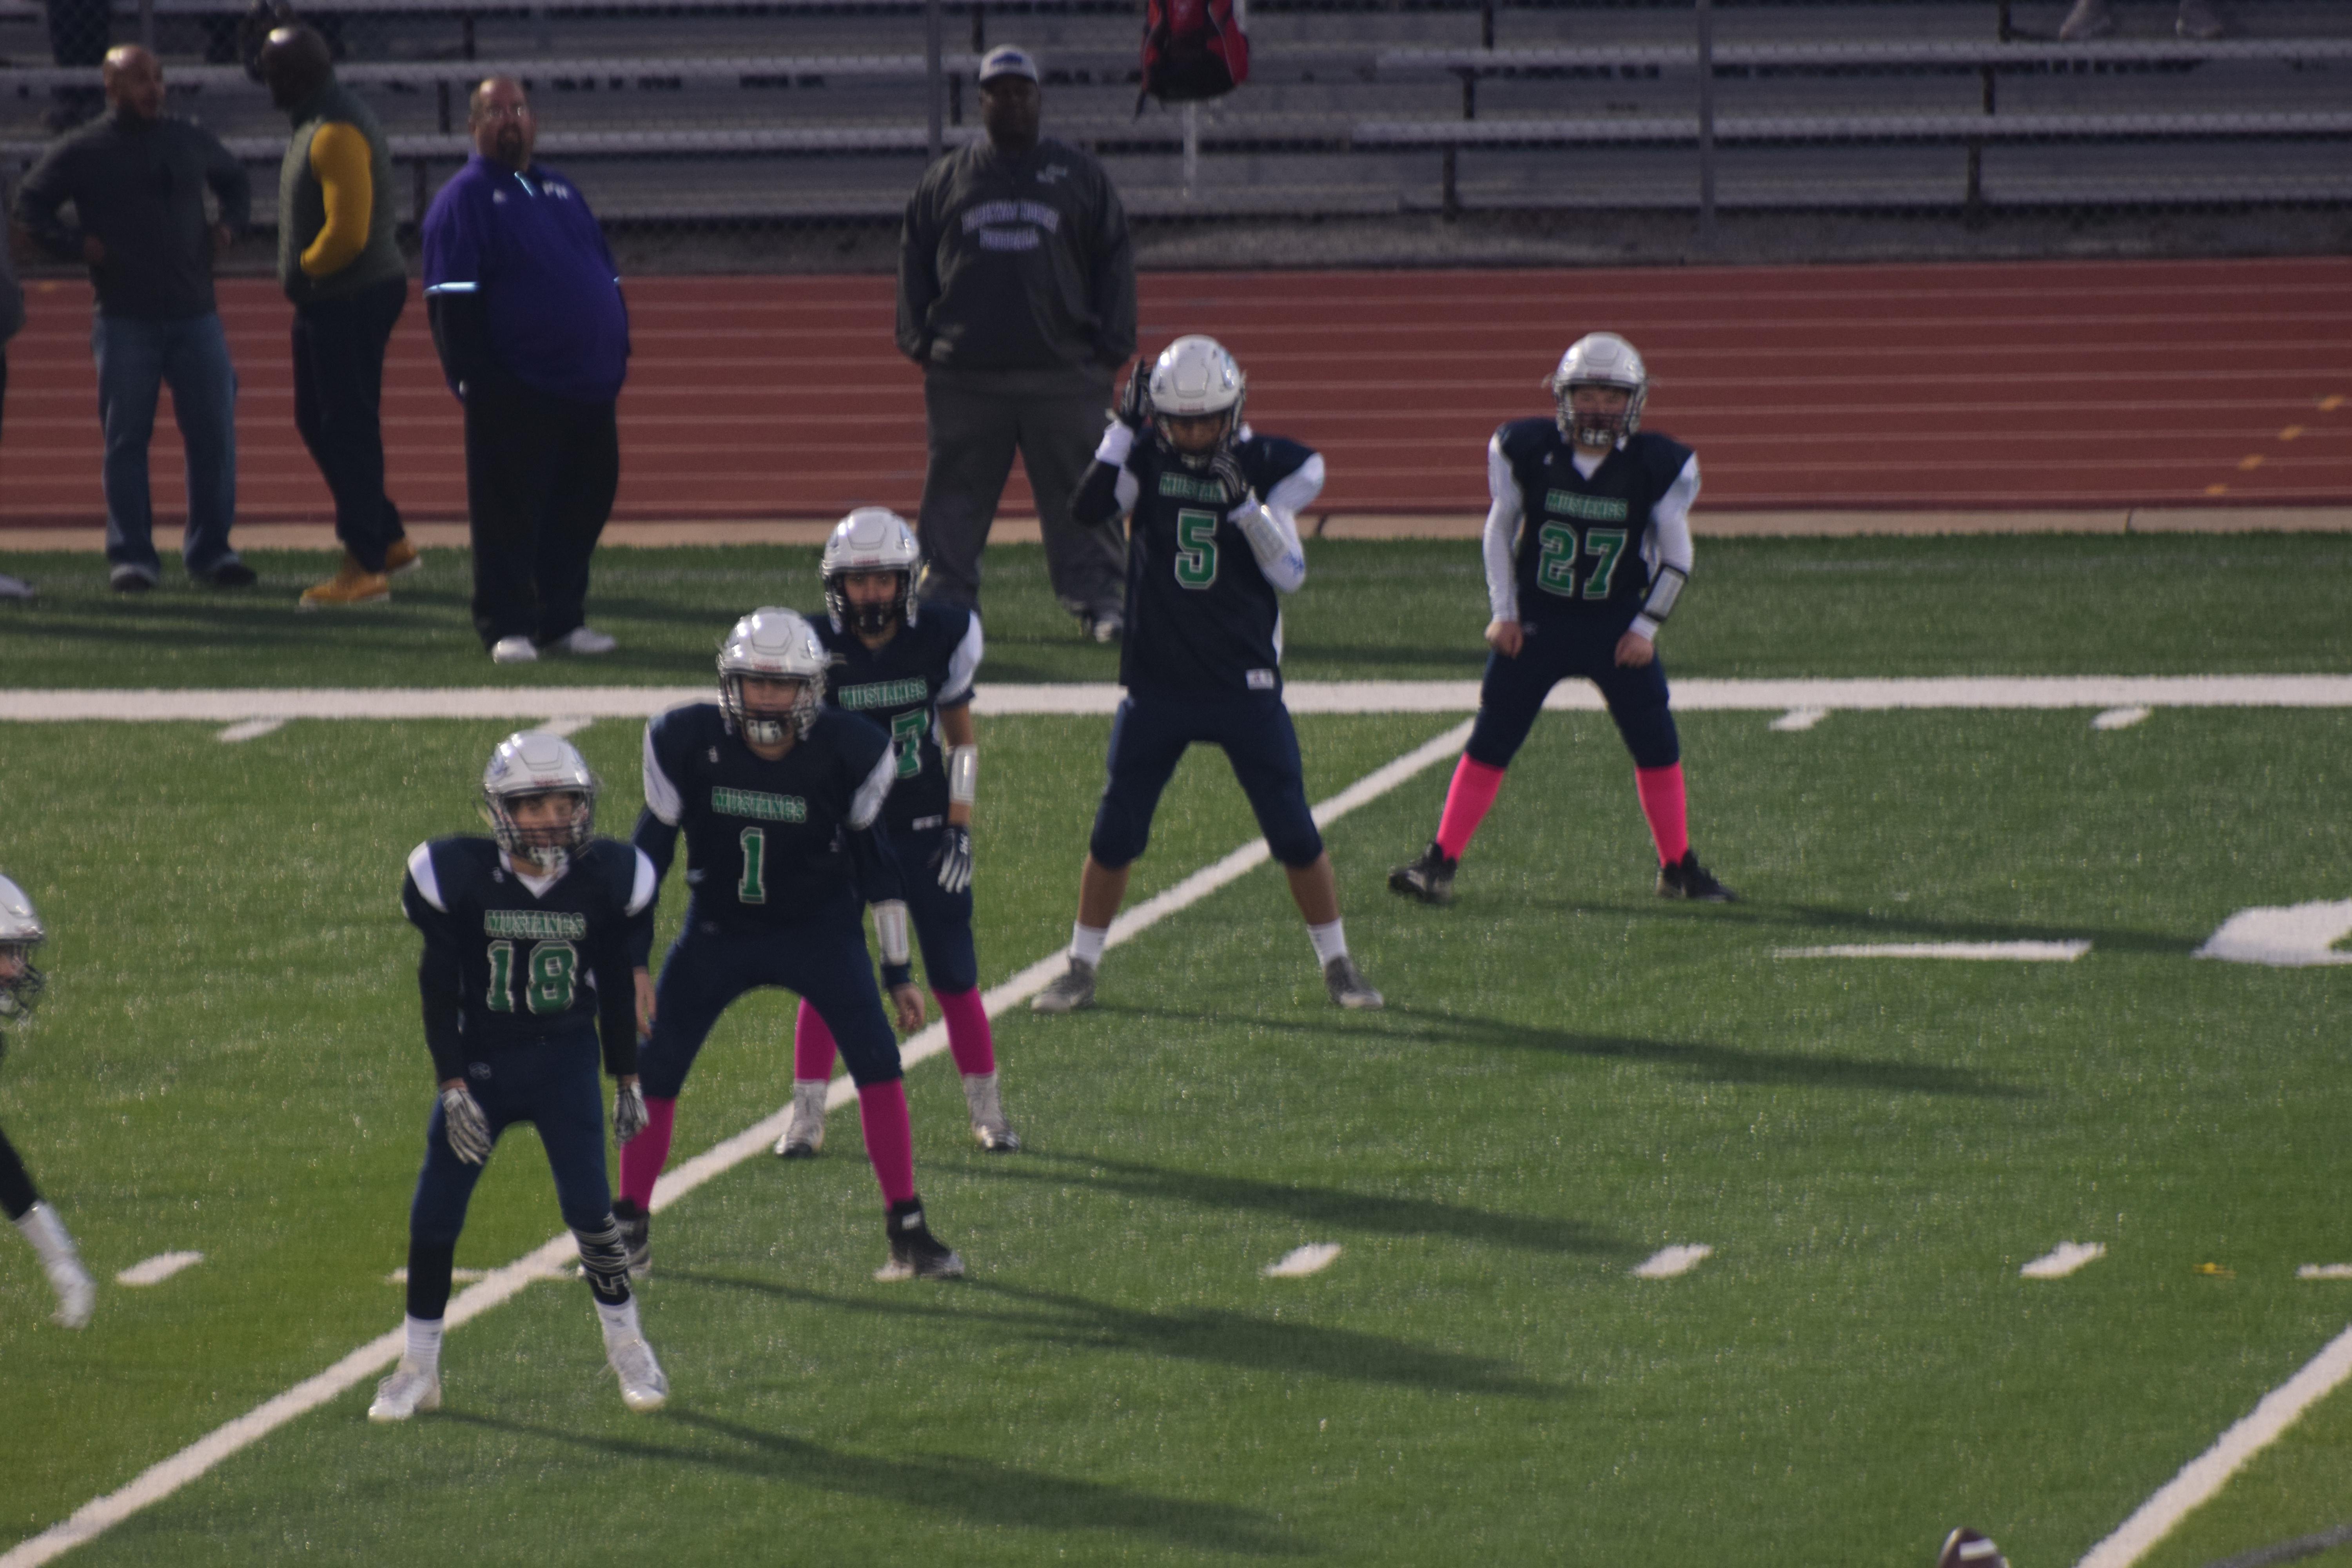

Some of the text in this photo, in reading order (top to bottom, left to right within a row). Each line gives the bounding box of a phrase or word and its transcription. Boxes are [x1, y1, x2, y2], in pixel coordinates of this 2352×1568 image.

[1544, 488, 1629, 522] MUSTANGS
[1174, 507, 1218, 590] 5
[1536, 519, 1629, 601] 27
[838, 674, 929, 711] MUSTANGS
[711, 786, 807, 824] MUSTANGS
[738, 826, 767, 904] 1
[484, 909, 586, 940] MUSTANGS
[486, 939, 579, 1015] 18
